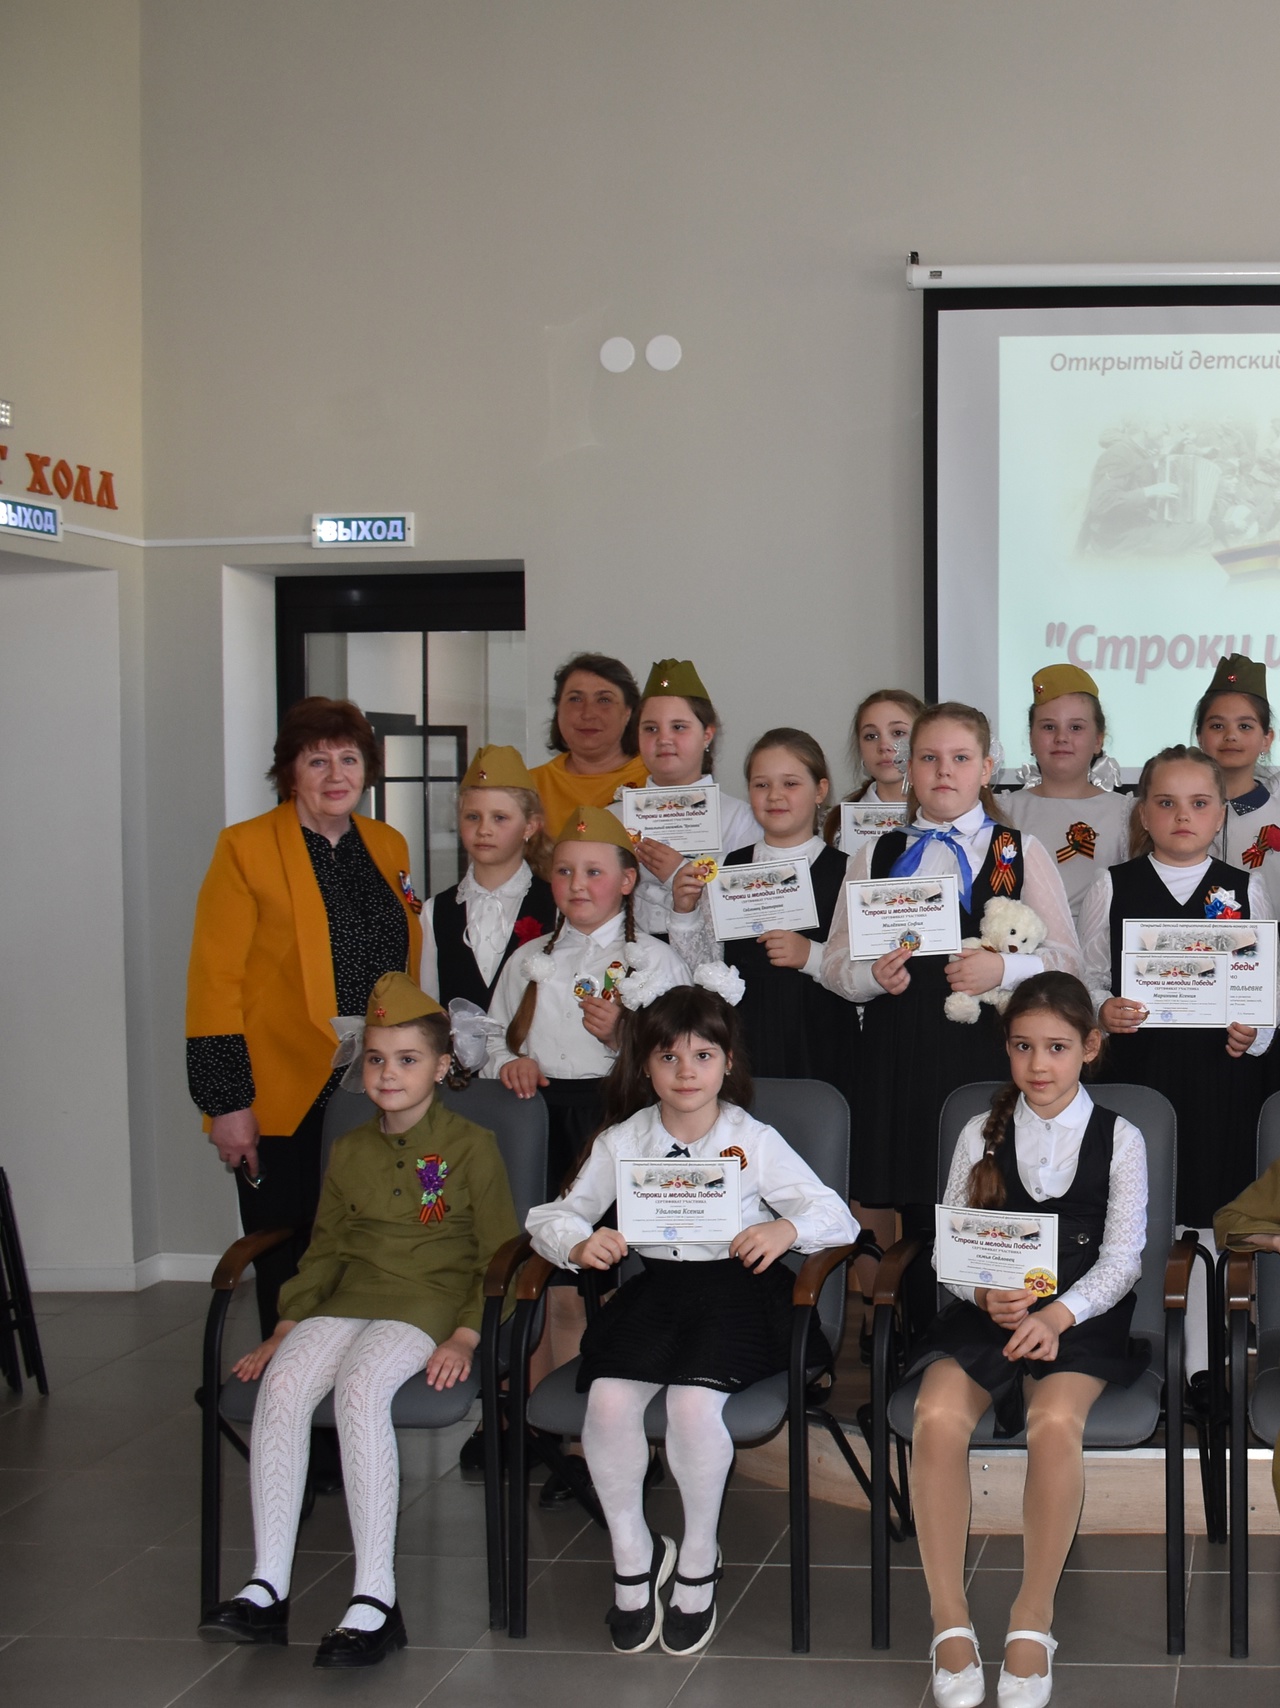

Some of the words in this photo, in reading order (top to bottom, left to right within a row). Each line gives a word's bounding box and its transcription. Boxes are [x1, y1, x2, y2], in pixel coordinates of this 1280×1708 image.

[1050, 351, 1183, 375] Открытый
[320, 520, 403, 541] ВЫХОД
[634, 1191, 661, 1199] "Строки
